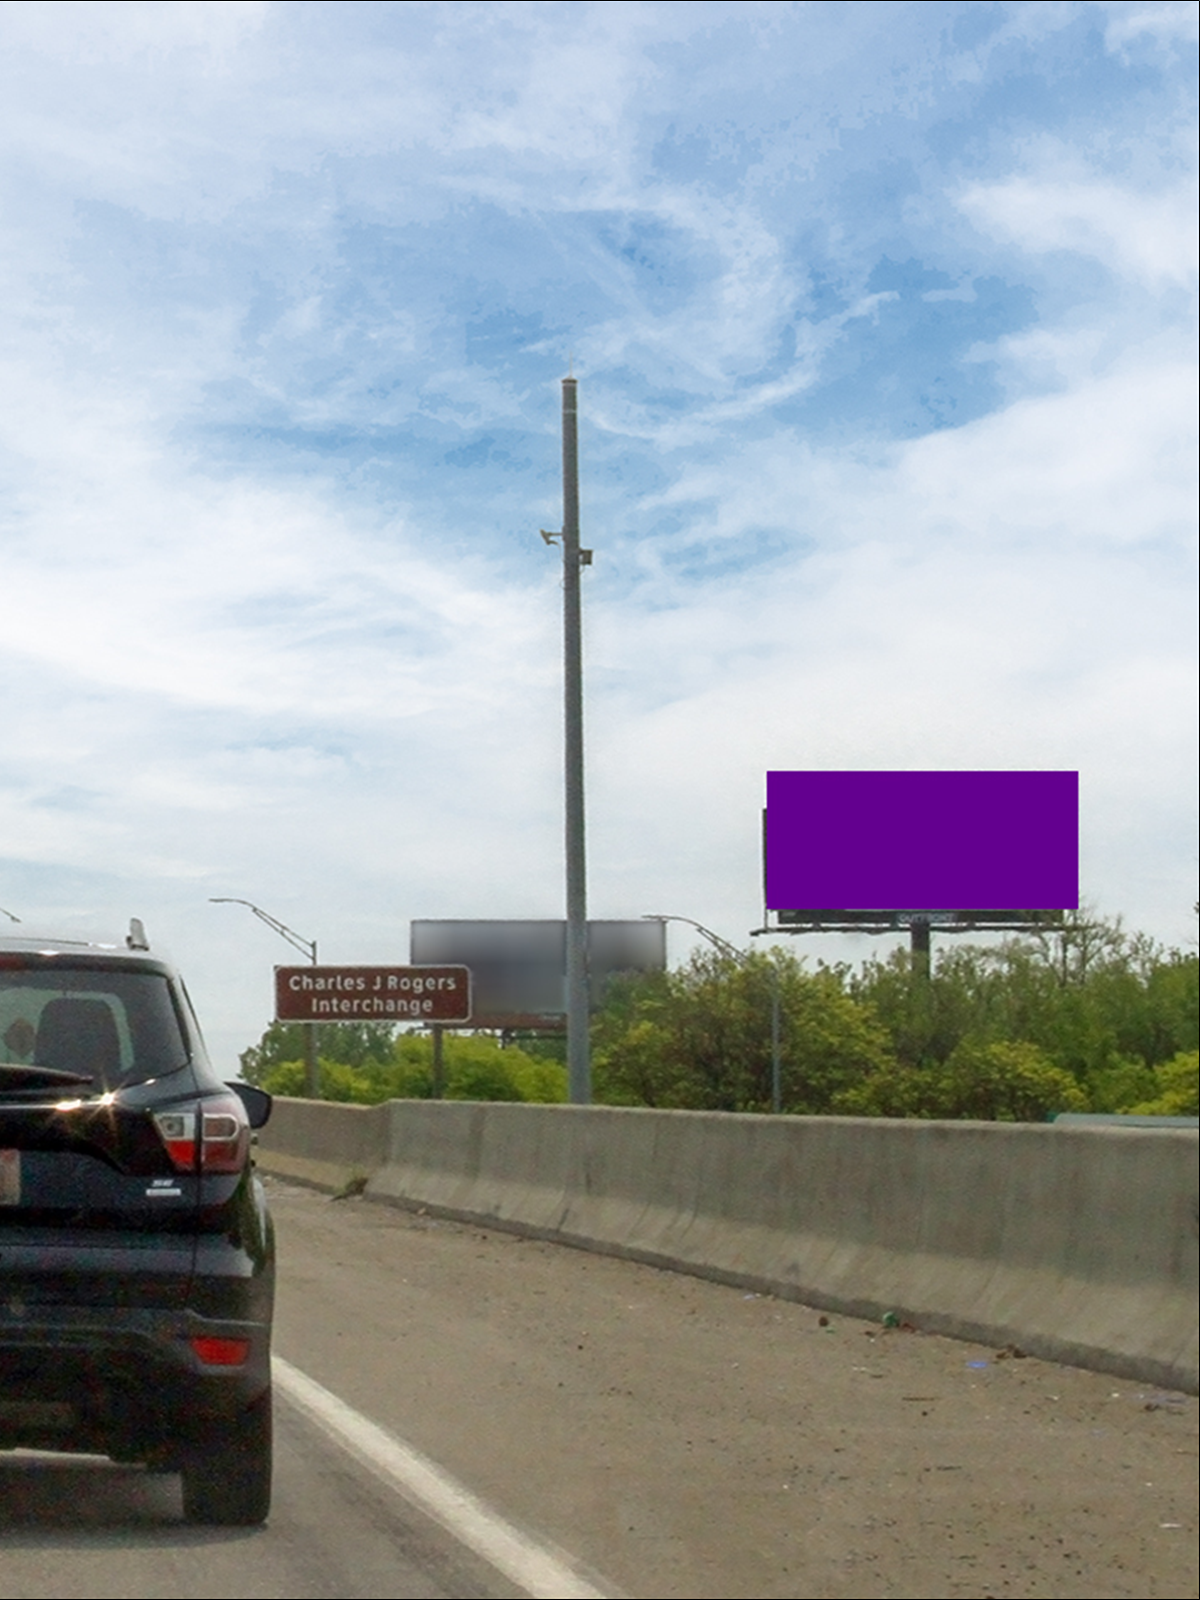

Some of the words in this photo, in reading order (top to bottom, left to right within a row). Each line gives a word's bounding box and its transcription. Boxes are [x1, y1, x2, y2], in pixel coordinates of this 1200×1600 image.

[288, 975, 366, 991] Charles
[372, 975, 381, 991] J
[387, 975, 457, 994] Rogers
[311, 997, 434, 1015] Interchange
